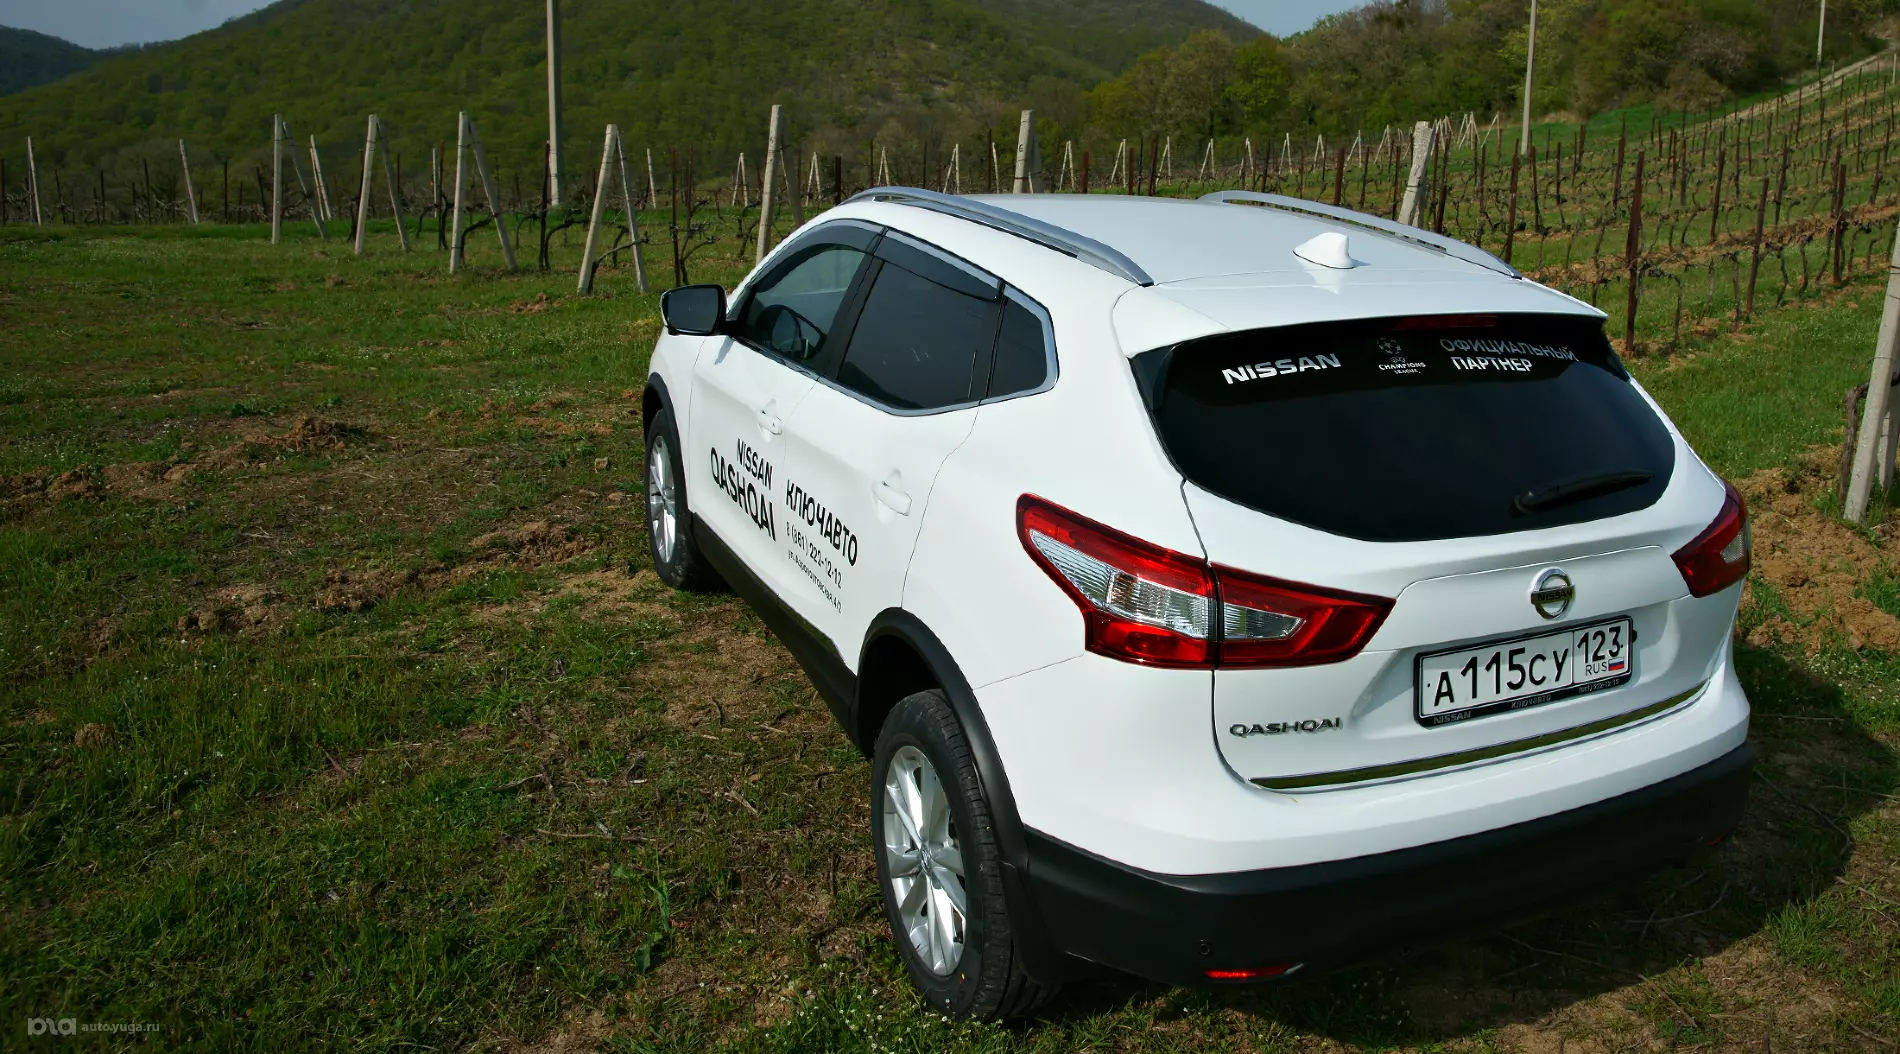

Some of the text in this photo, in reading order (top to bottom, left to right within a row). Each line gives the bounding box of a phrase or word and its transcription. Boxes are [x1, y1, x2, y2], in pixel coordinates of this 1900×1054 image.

[1439, 338, 1580, 363] ОФИЦИАЛЬНЫЙ
[1221, 353, 1342, 385] NISSAN
[1378, 361, 1427, 371] CHAMPIONS
[1450, 356, 1533, 373] ПАРТНЕР
[736, 438, 773, 490] NISSAN
[710, 447, 776, 542] QASHQAI
[785, 479, 858, 567] КЛЮЧАВТО
[809, 542, 842, 590] 222-12-12
[1536, 586, 1574, 601] NISSAN
[1576, 625, 1622, 664] 123
[1585, 661, 1608, 677] RUS
[1229, 717, 1342, 738] QASHQAI
[1433, 710, 1472, 726] NISSAN
